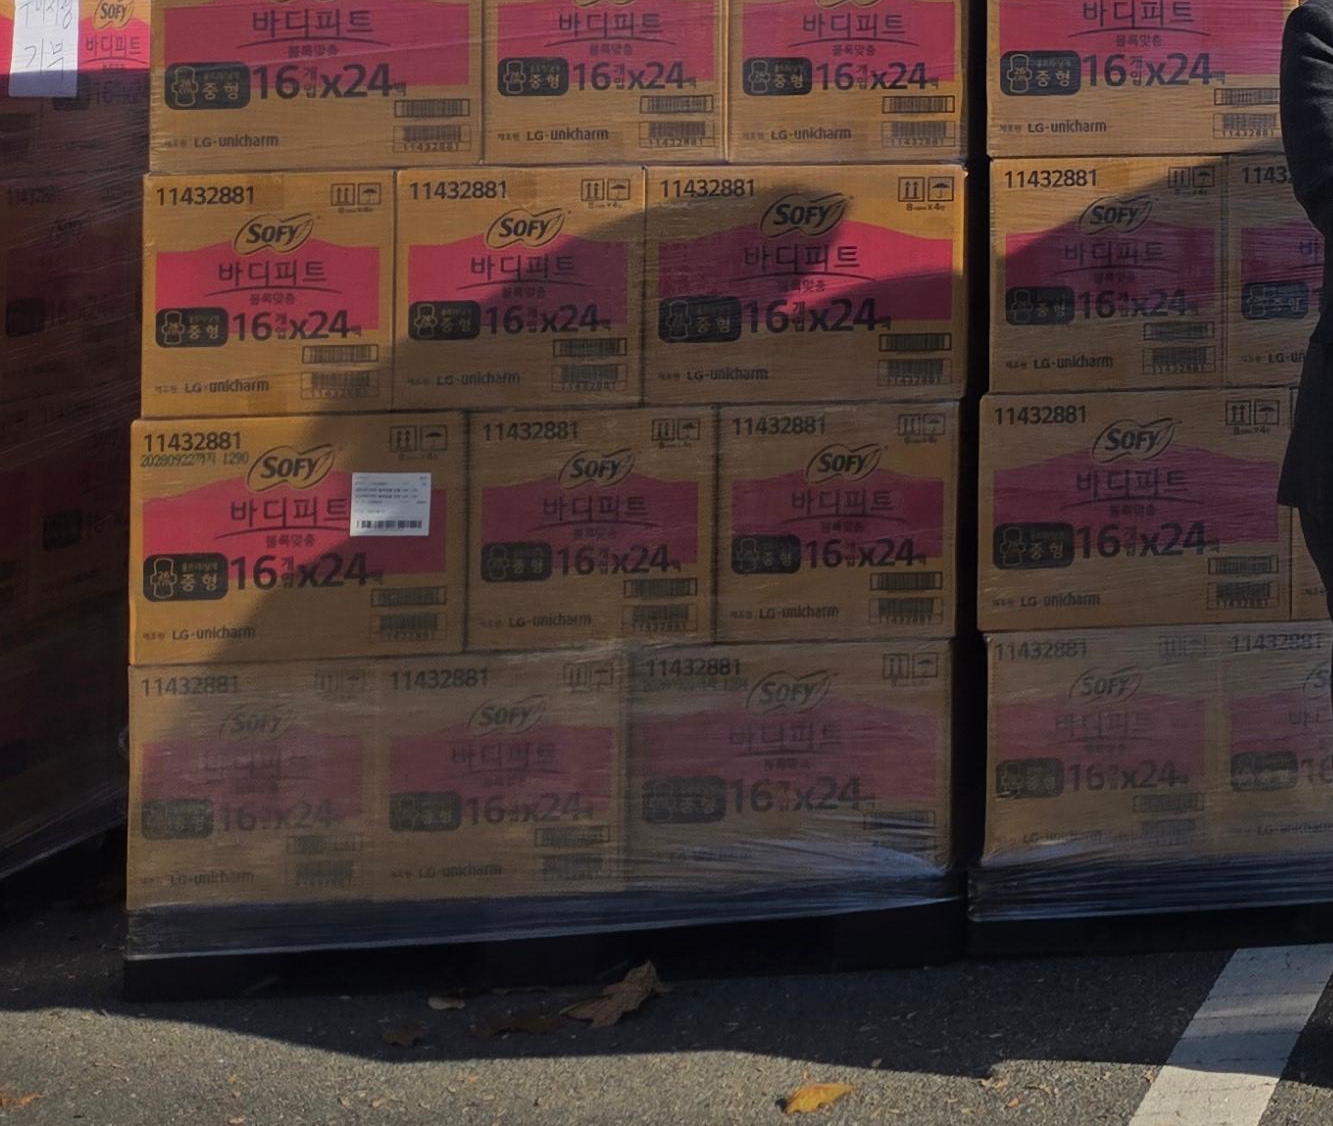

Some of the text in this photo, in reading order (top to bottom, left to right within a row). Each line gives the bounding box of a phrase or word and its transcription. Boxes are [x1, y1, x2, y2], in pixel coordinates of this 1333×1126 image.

[100, 2, 128, 24] SOFY
[252, 8, 374, 38] 바디피트
[1082, 0, 1195, 29] 바디피트
[558, 10, 664, 38] 바디피트
[802, 11, 906, 38] 바디피트
[86, 35, 141, 58] 바디피트
[24, 37, 64, 81] 기부
[529, 73, 563, 92] 중형
[773, 73, 806, 91] 중형
[1035, 69, 1072, 88] 중형
[202, 82, 240, 101] 중형
[526, 126, 610, 143] LG-unicharm
[770, 126, 852, 143] LG-unicharm
[1027, 119, 1107, 134] LG-unicharm
[194, 134, 280, 148] LG-unicharm
[660, 179, 754, 198] 11432881
[1004, 169, 1098, 189] 11432881
[156, 186, 255, 206] 11432881
[409, 181, 508, 201] 11432881
[773, 204, 830, 227] SOFY
[1090, 205, 1141, 226] SOFY
[245, 224, 303, 247] SOFY
[498, 218, 554, 240] SOFY
[744, 245, 860, 273] 바디피트
[1064, 240, 1164, 266] 바디피트
[217, 260, 327, 288] 바디피트
[469, 255, 575, 284] 바디피트
[186, 320, 219, 340] 중형
[1033, 355, 1114, 369] LG-unicharm
[436, 371, 521, 388] LG-unicharm
[686, 368, 769, 381] LG-unicharm
[185, 378, 270, 394] LG-unicharm
[993, 405, 1087, 425] 11432881
[483, 421, 578, 441] 11432881
[732, 417, 825, 436] 11432881
[144, 432, 241, 452] 11432881
[1104, 430, 1159, 453] SOFY
[260, 455, 319, 479] SOFY
[571, 458, 621, 480] SOFY
[817, 452, 867, 475] SOFY
[1076, 468, 1190, 498] 바디피트
[543, 494, 650, 521] 바디피트
[791, 488, 894, 514] 바디피트
[230, 496, 349, 529] 바디피트
[508, 611, 592, 628] LG-unicharm
[758, 603, 840, 620] LG-unicharm
[171, 625, 256, 640] LG-unicharm
[995, 641, 1087, 661] 11432881
[645, 658, 741, 676] 11432881
[141, 676, 240, 697] 11432881
[390, 667, 488, 691] 11432881
[480, 705, 532, 727] SOFY
